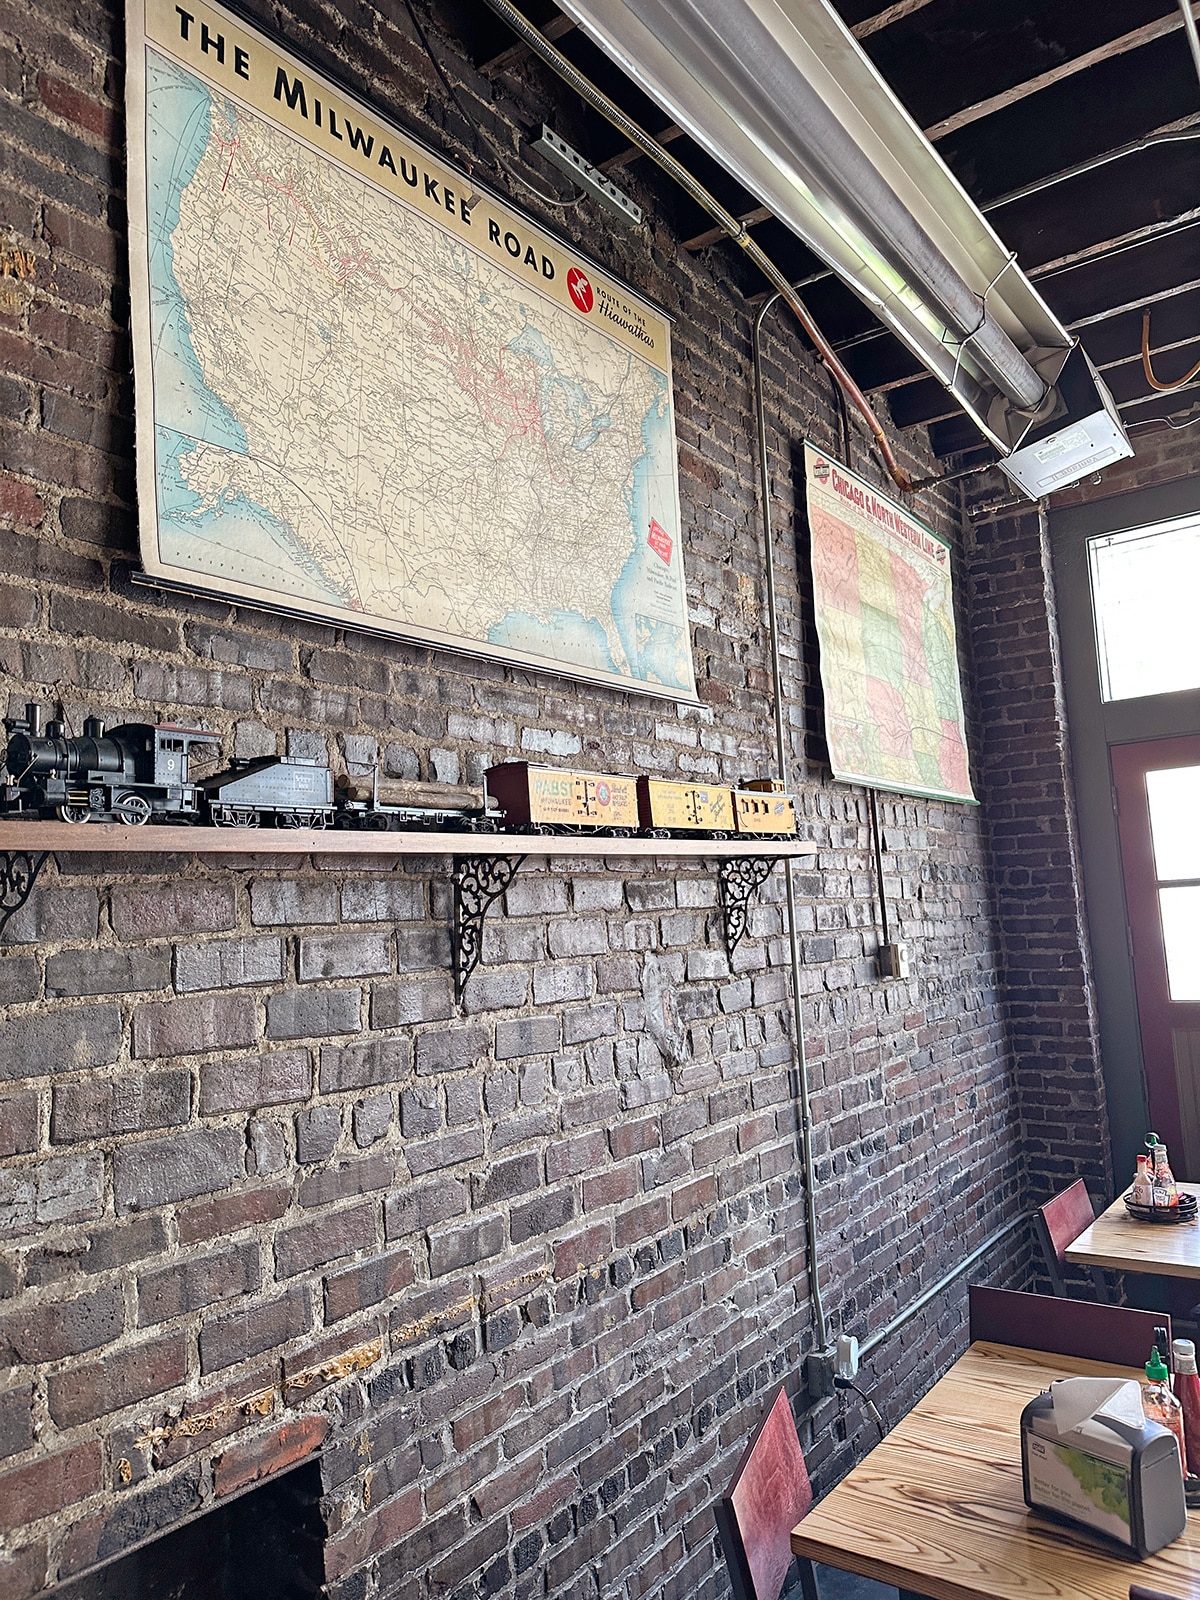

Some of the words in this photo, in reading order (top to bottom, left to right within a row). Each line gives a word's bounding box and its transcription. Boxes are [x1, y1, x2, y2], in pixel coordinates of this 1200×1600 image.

[175, 5, 250, 81] THE
[273, 66, 472, 226] MILWAUKEE
[488, 217, 556, 281] ROAD
[596, 286, 620, 308] ROUTE
[622, 305, 631, 316] OF
[633, 312, 647, 327] THE
[597, 300, 655, 349] Hiawathas
[832, 469, 865, 512] CHICAGO
[866, 495, 872, 515] &
[871, 496, 895, 530] NORTH
[893, 512, 922, 551] WESTERN
[921, 532, 936, 559] LINE
[167, 759, 175, 771] 9
[536, 779, 575, 798] PABST
